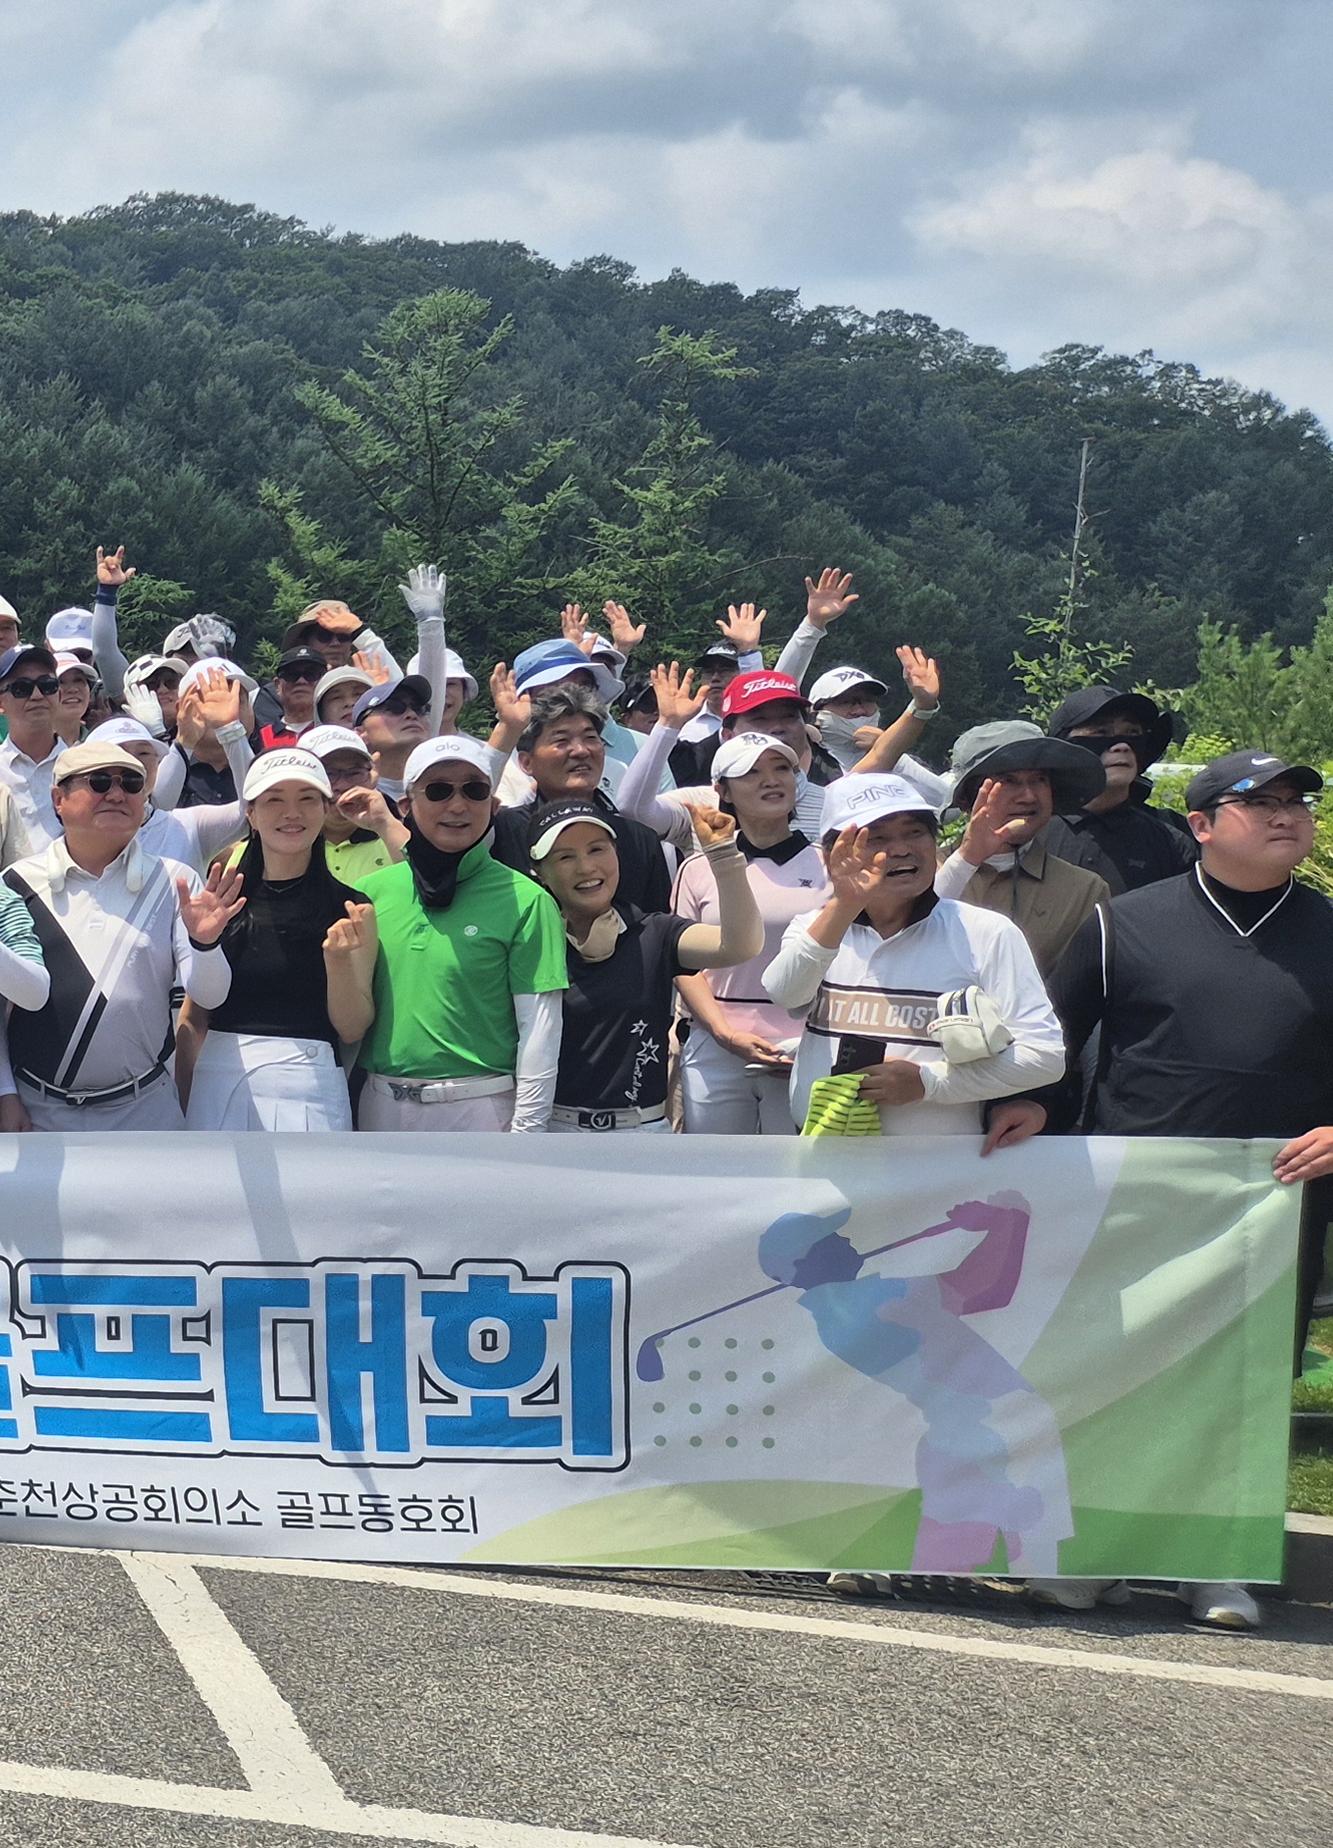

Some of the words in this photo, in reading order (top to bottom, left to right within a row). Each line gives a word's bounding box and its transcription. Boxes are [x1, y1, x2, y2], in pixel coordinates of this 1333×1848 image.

[740, 678, 797, 698] Titleist
[309, 728, 359, 751] Titleist
[435, 741, 460, 752] alo
[261, 755, 318, 774] Titleist
[847, 1001, 879, 1027] ALL
[276, 1489, 480, 1535] 골프동호회
